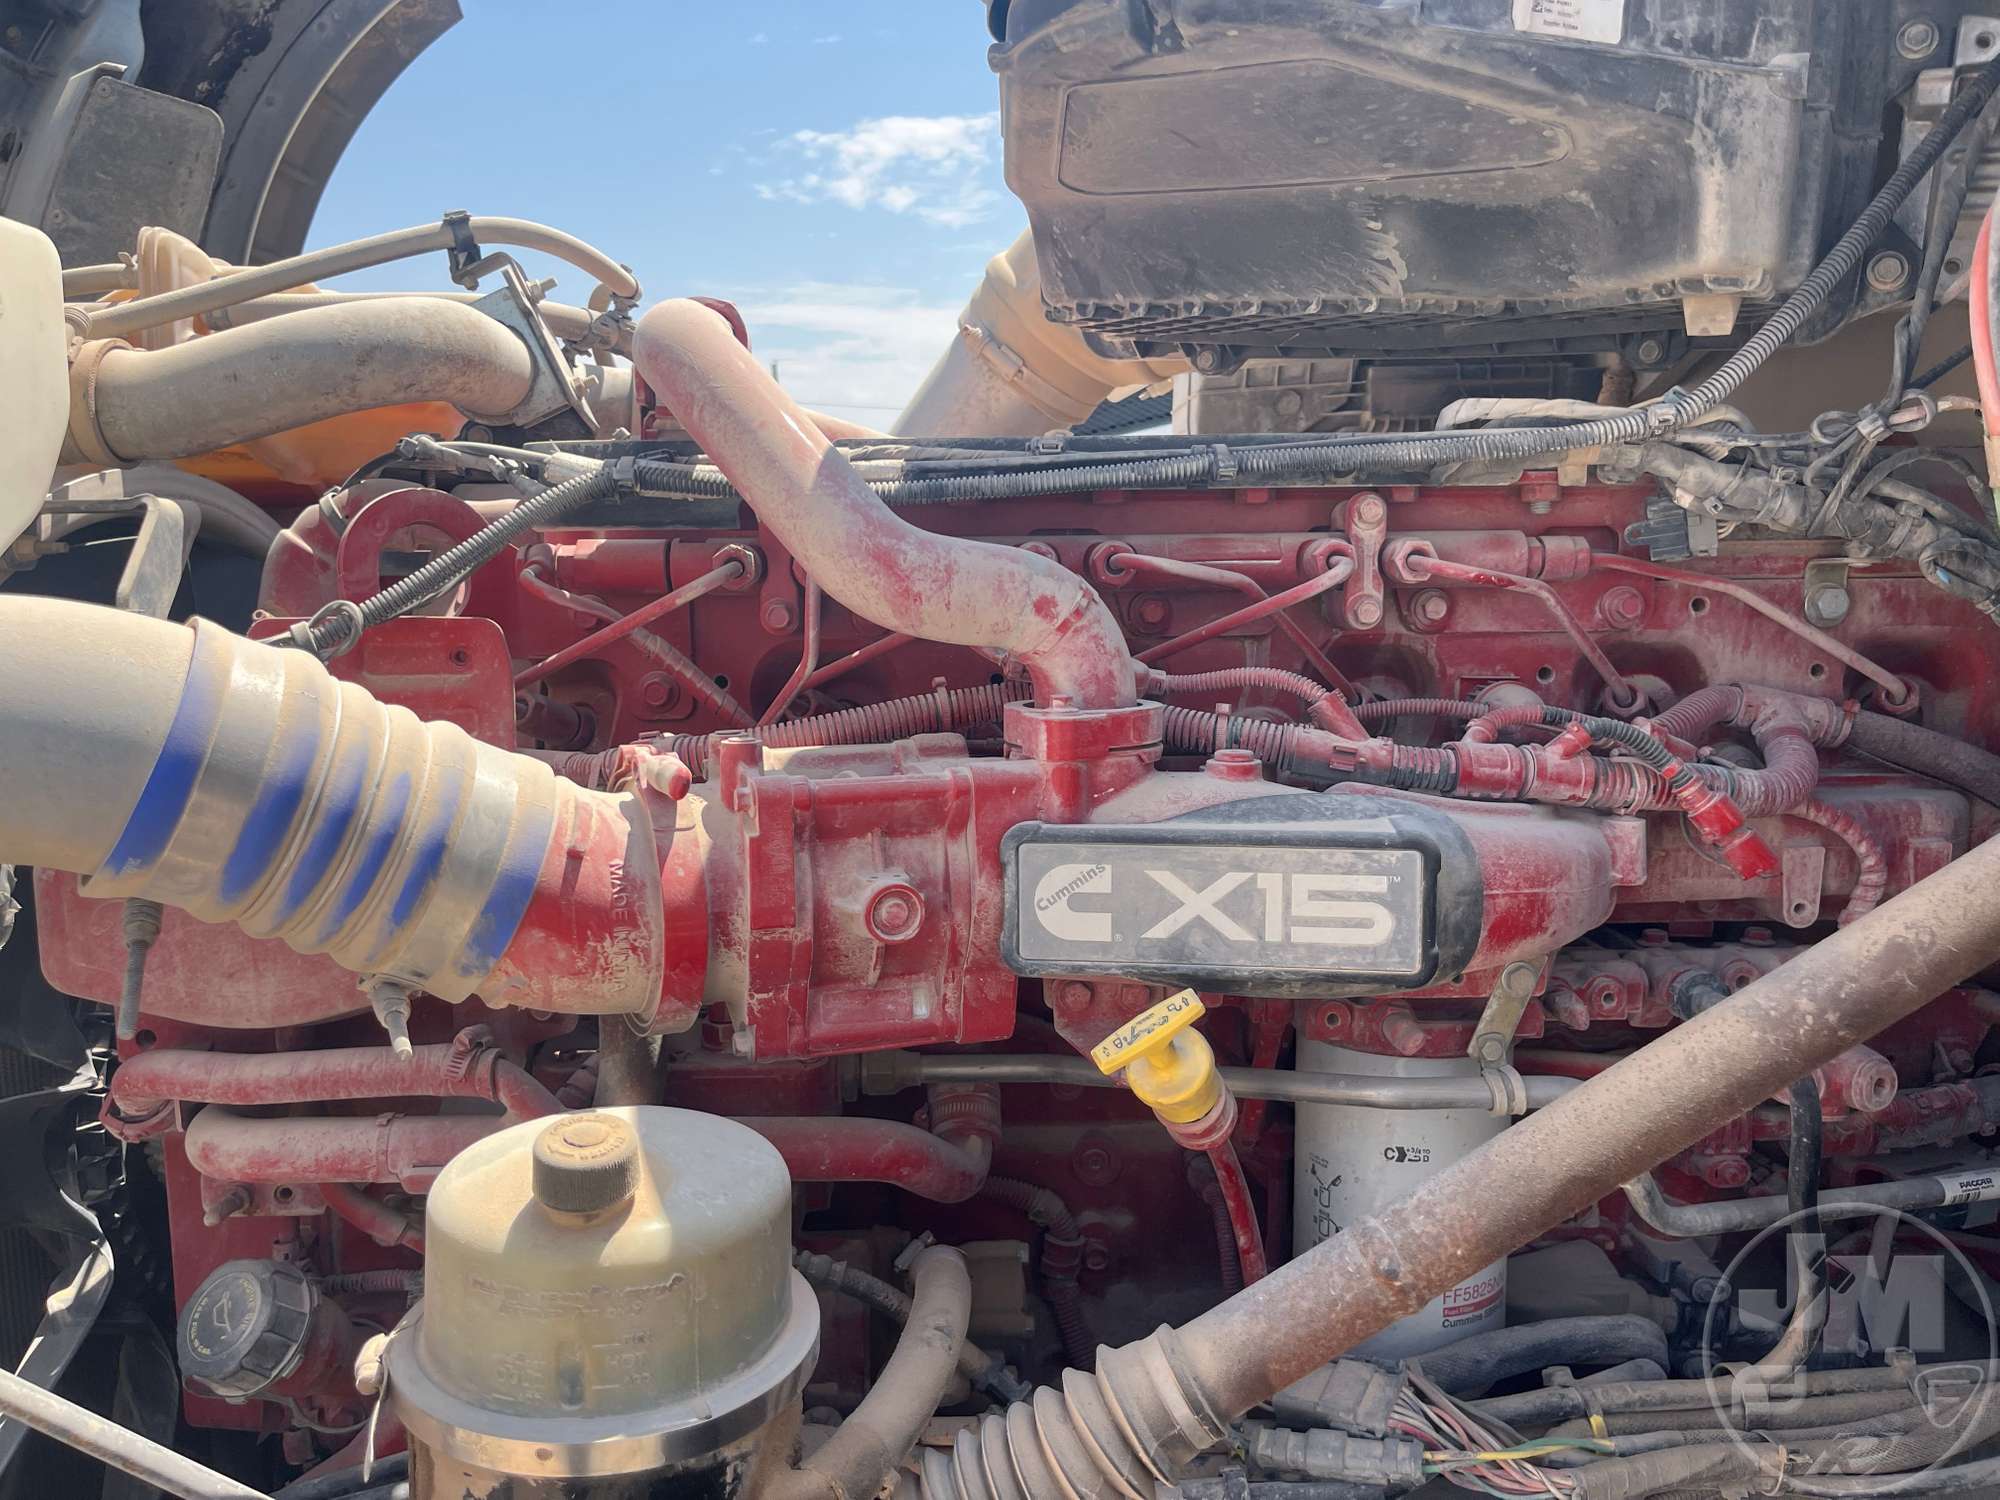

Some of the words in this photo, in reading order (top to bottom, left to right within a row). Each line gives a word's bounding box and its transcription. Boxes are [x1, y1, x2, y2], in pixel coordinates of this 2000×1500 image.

[609, 858, 630, 920] MADE
[1035, 863, 1106, 912] Cummins
[1140, 869, 1396, 945] X15
[1959, 1178, 1992, 1188] PACCAR
